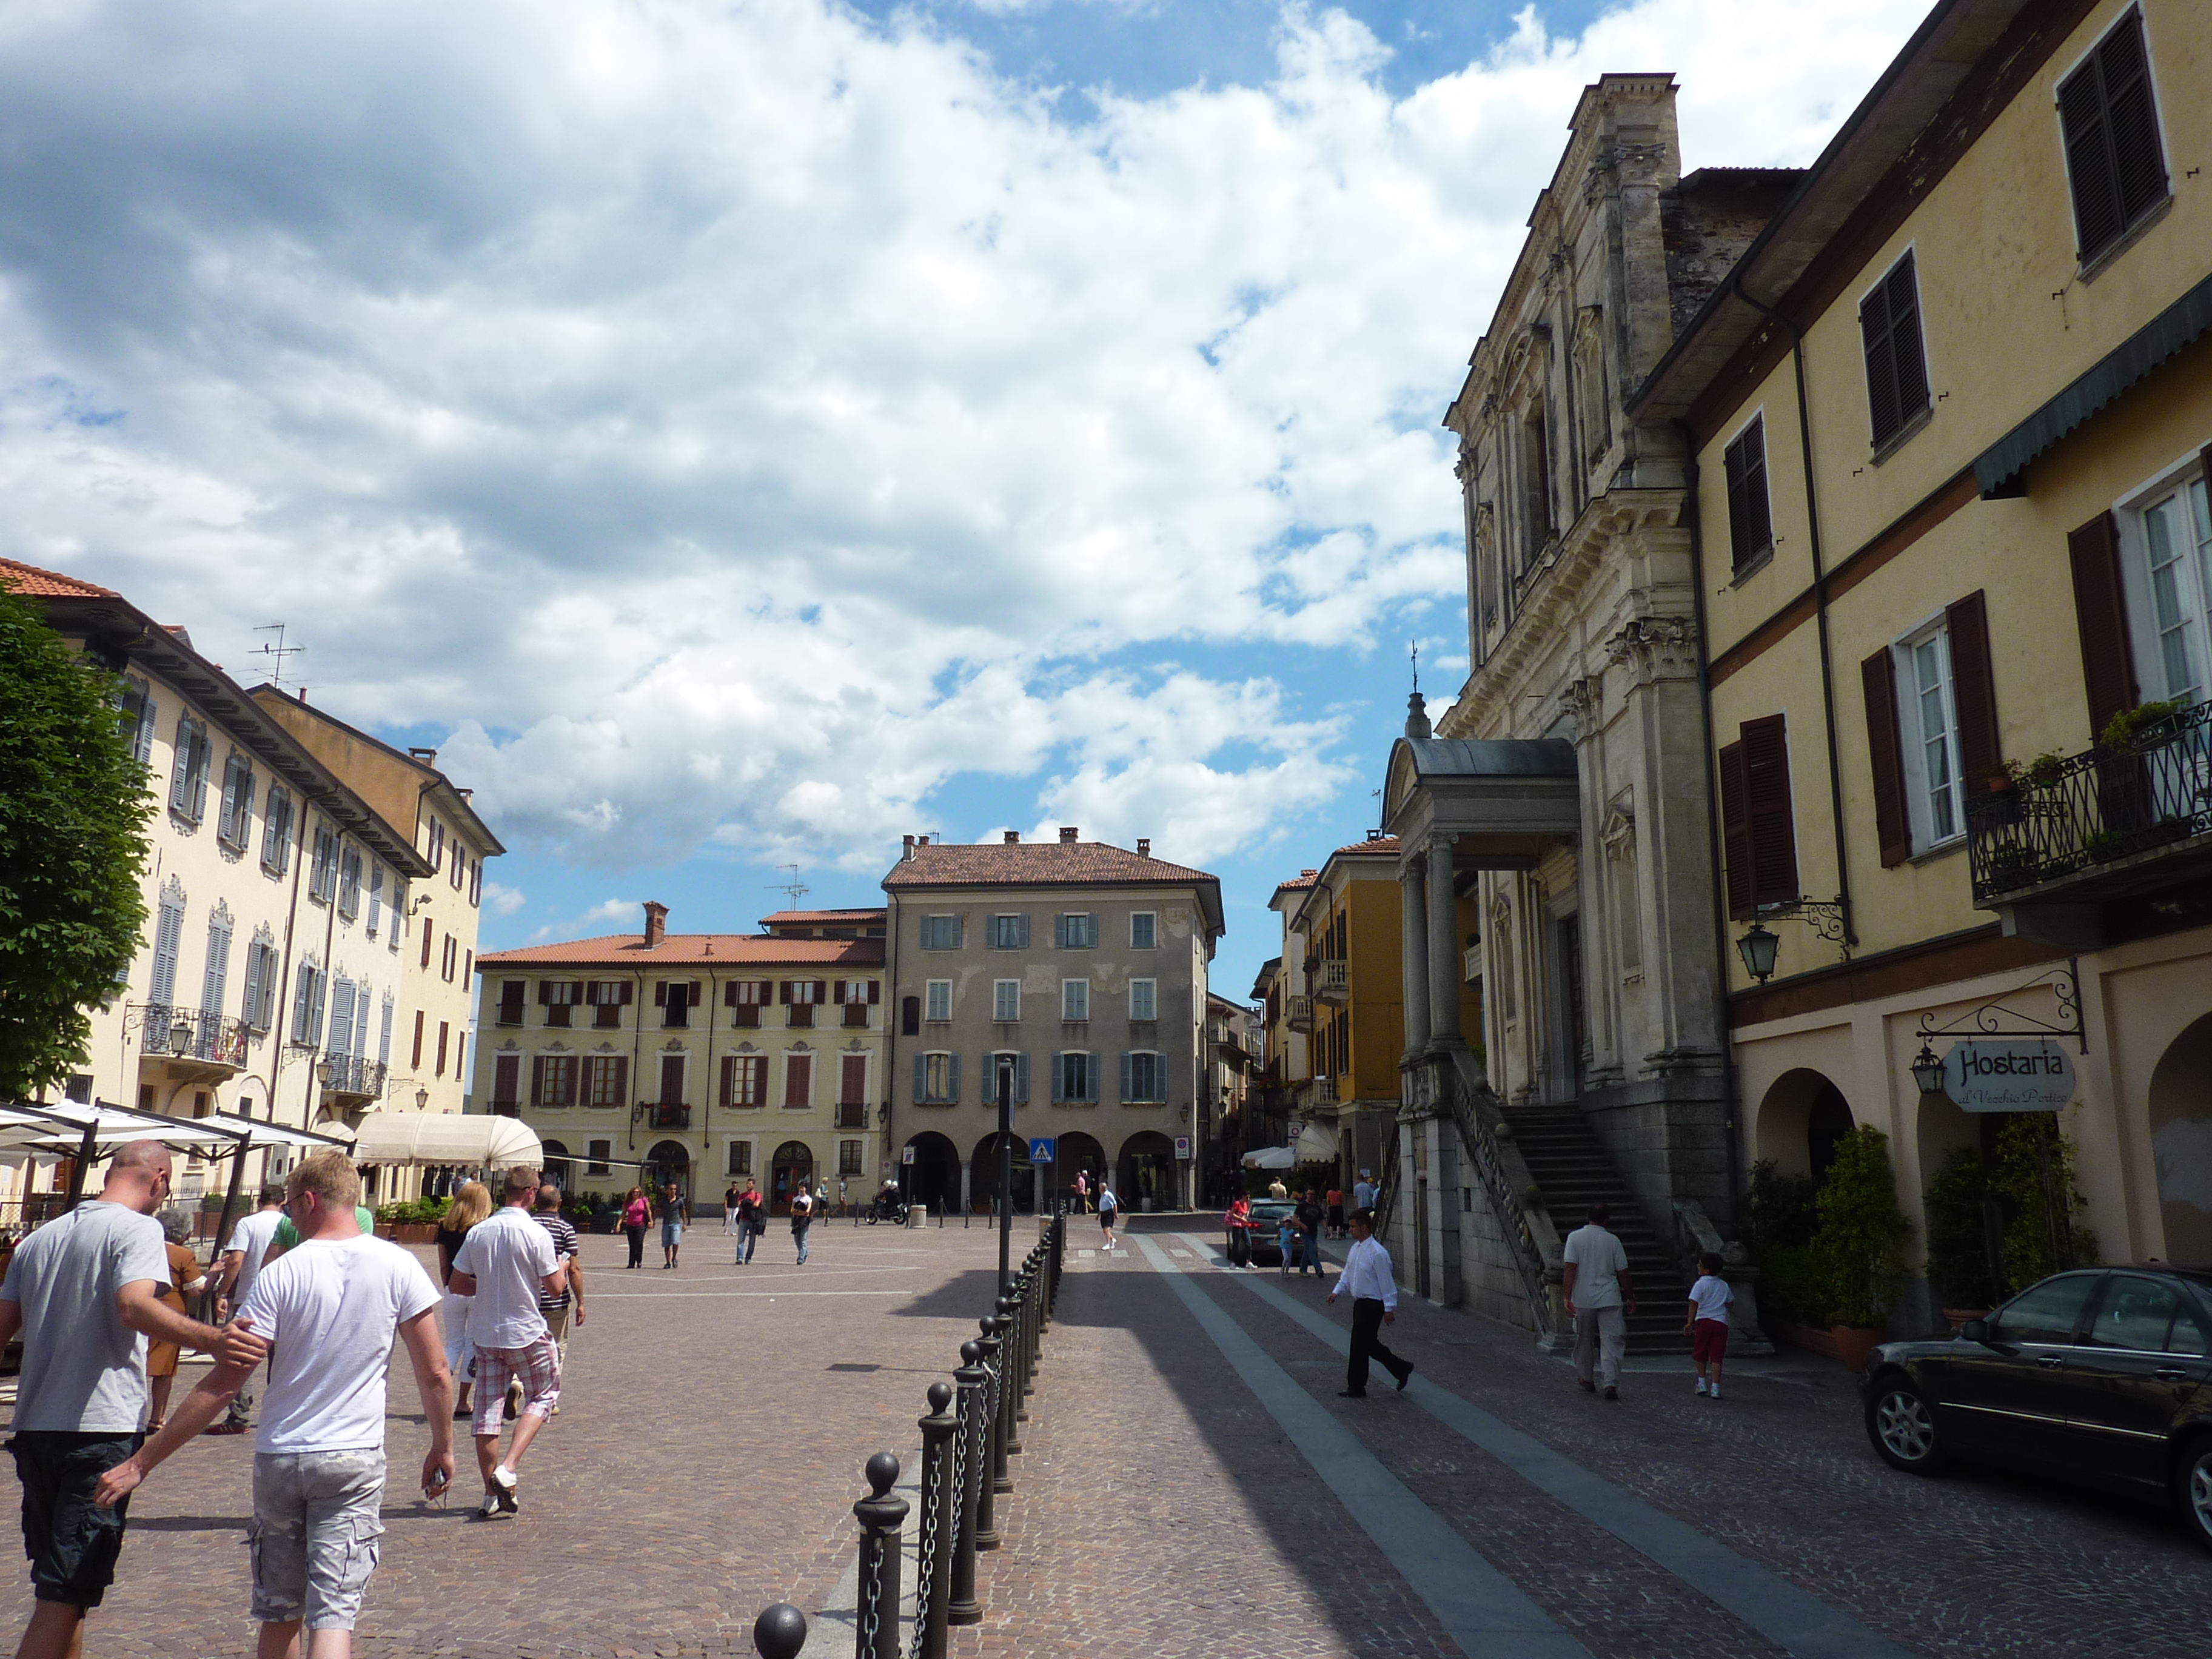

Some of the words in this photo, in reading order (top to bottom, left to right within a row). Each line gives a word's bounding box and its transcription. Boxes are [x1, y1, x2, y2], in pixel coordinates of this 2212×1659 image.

[1960, 1049, 2063, 1087] Hostaria
[1959, 1090, 1972, 1104] al
[1973, 1089, 2019, 1104] Vecchio
[2022, 1088, 2066, 1103] Portico
